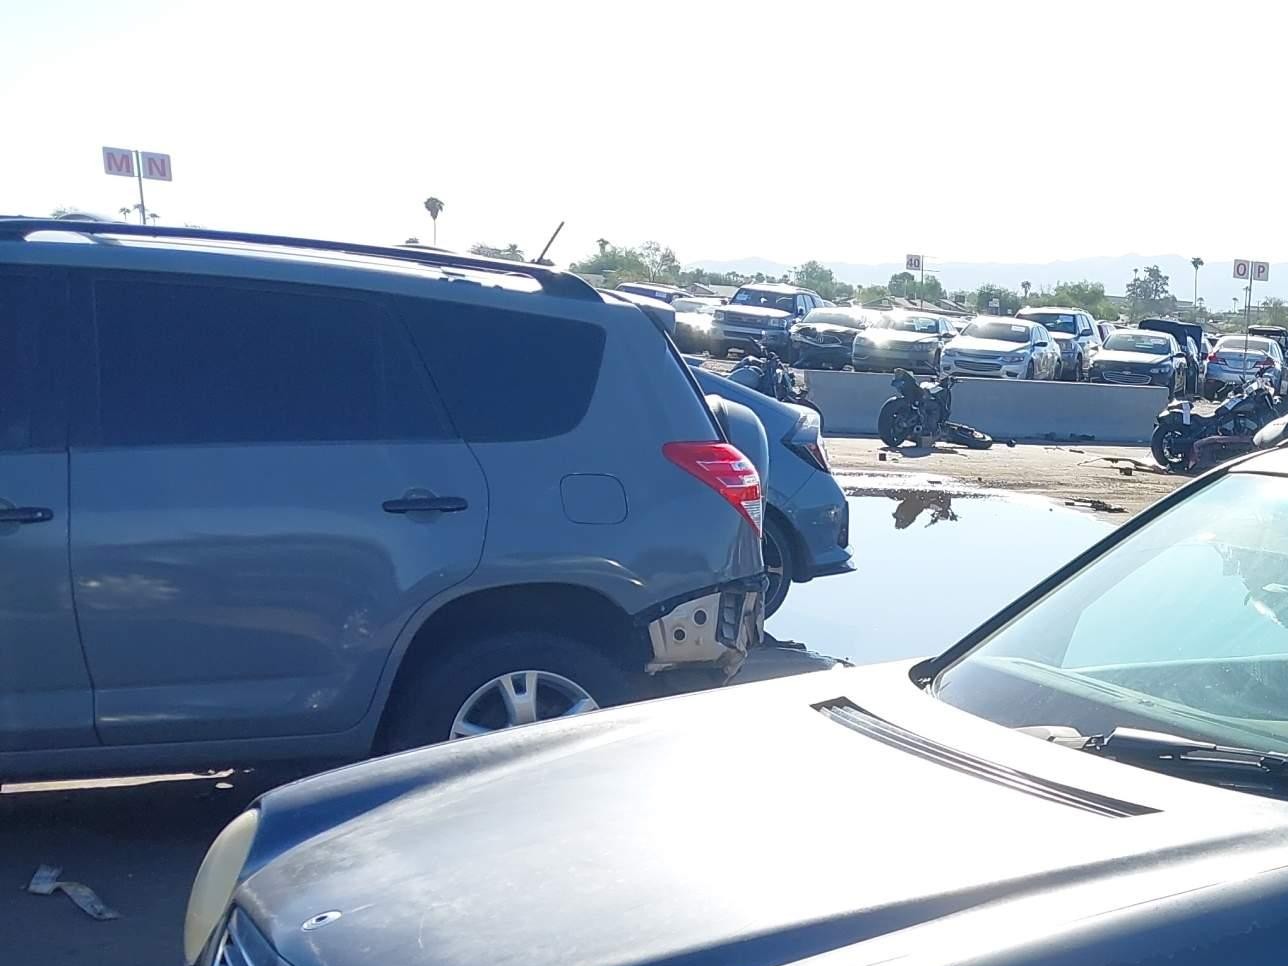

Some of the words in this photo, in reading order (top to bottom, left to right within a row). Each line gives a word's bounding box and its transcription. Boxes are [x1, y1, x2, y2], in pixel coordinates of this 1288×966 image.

[106, 152, 131, 173] M
[147, 157, 167, 177] N
[1236, 262, 1247, 277] O
[1257, 264, 1266, 278] P
